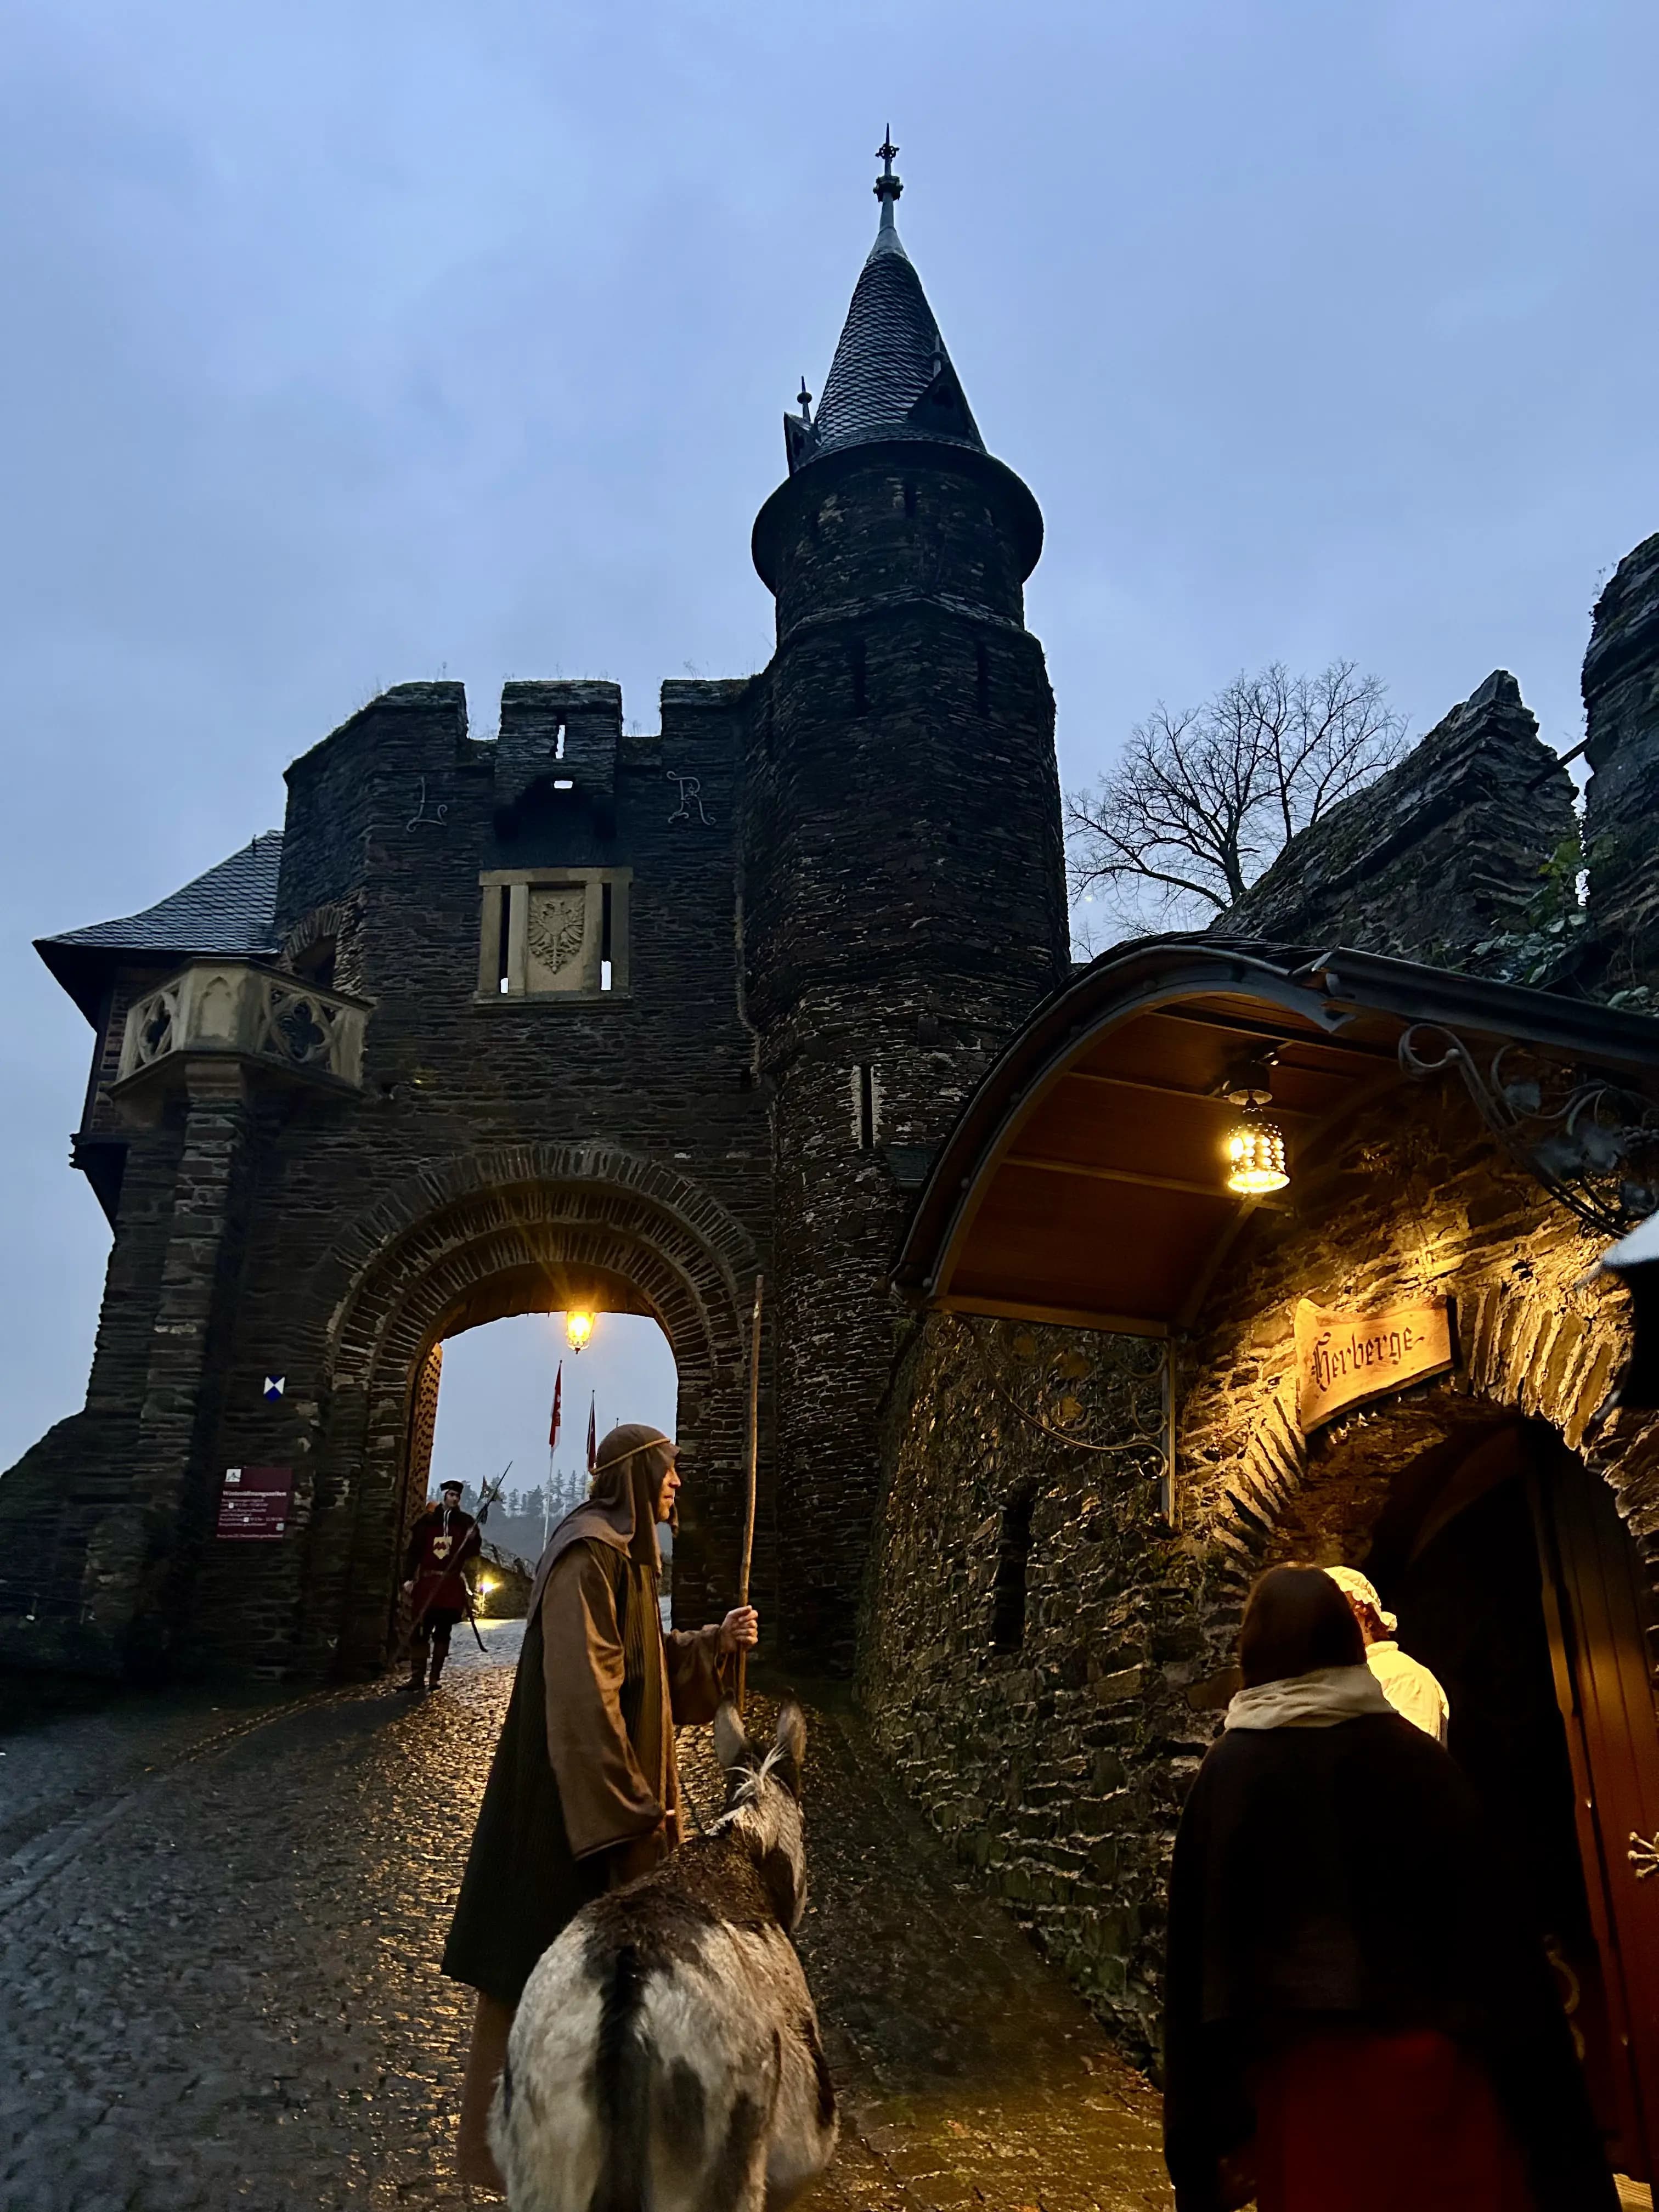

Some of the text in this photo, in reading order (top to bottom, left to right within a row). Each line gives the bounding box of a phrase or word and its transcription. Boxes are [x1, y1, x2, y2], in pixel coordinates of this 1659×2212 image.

[407, 776, 448, 832] L
[666, 771, 716, 826] R
[1311, 1327, 1425, 1392] Herberge
